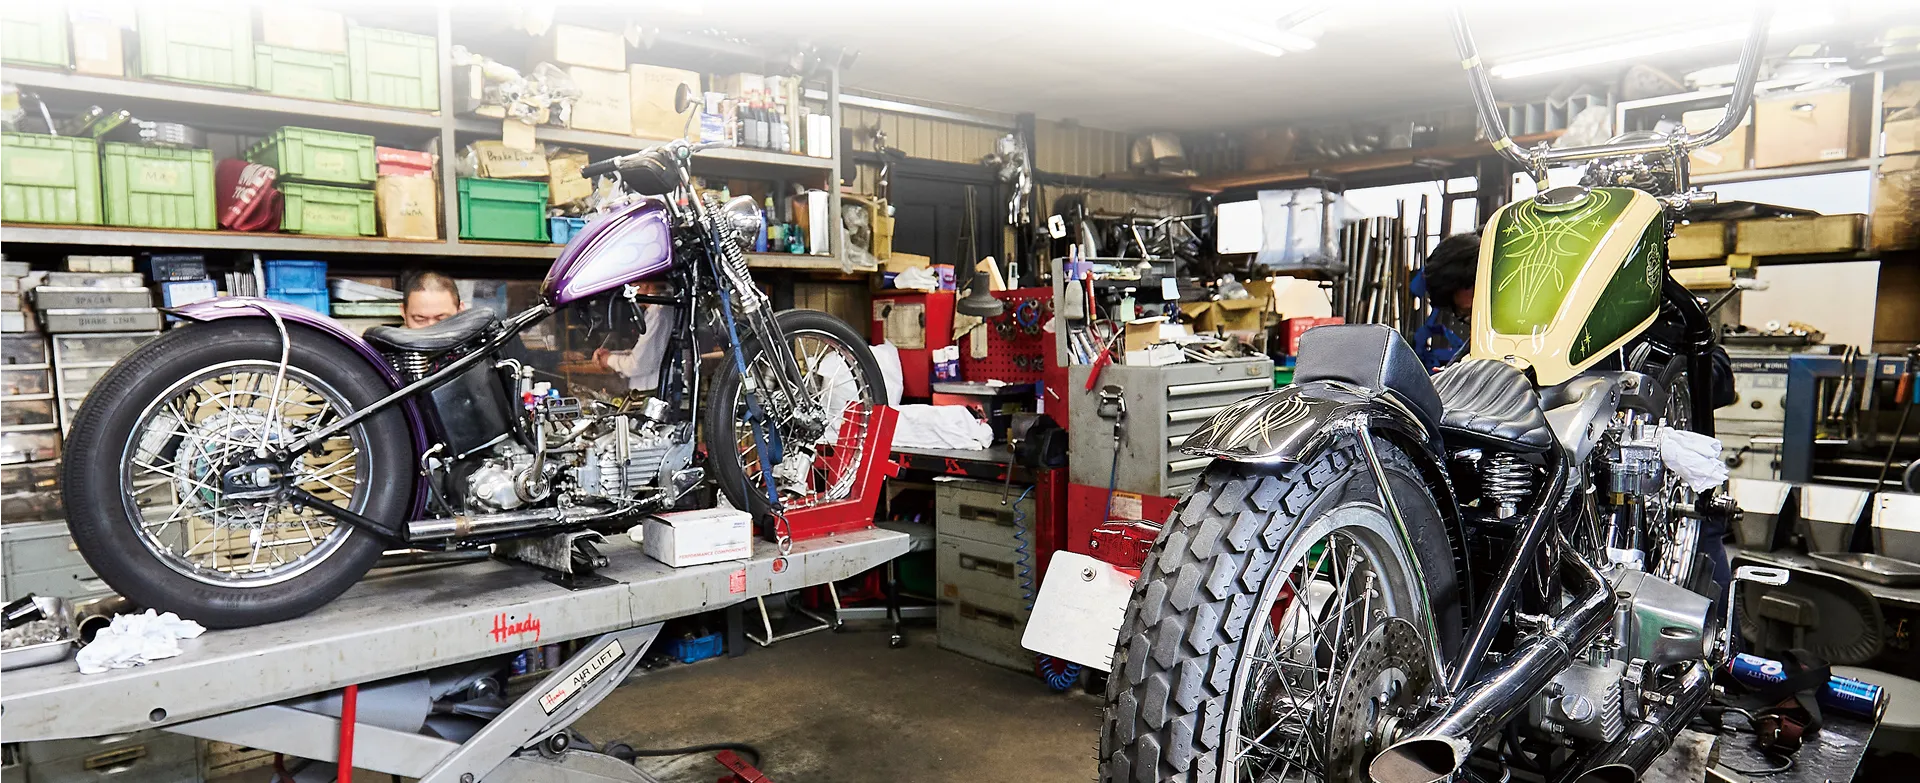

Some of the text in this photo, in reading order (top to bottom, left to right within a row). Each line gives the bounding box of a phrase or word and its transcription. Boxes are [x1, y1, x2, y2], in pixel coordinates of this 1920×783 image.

[487, 151, 534, 161] Brake Line
[679, 546, 747, 560] PERFORMANCE COMPONENTS
[489, 612, 541, 643] Handy
[545, 649, 613, 705] Handy AIR LIFT
